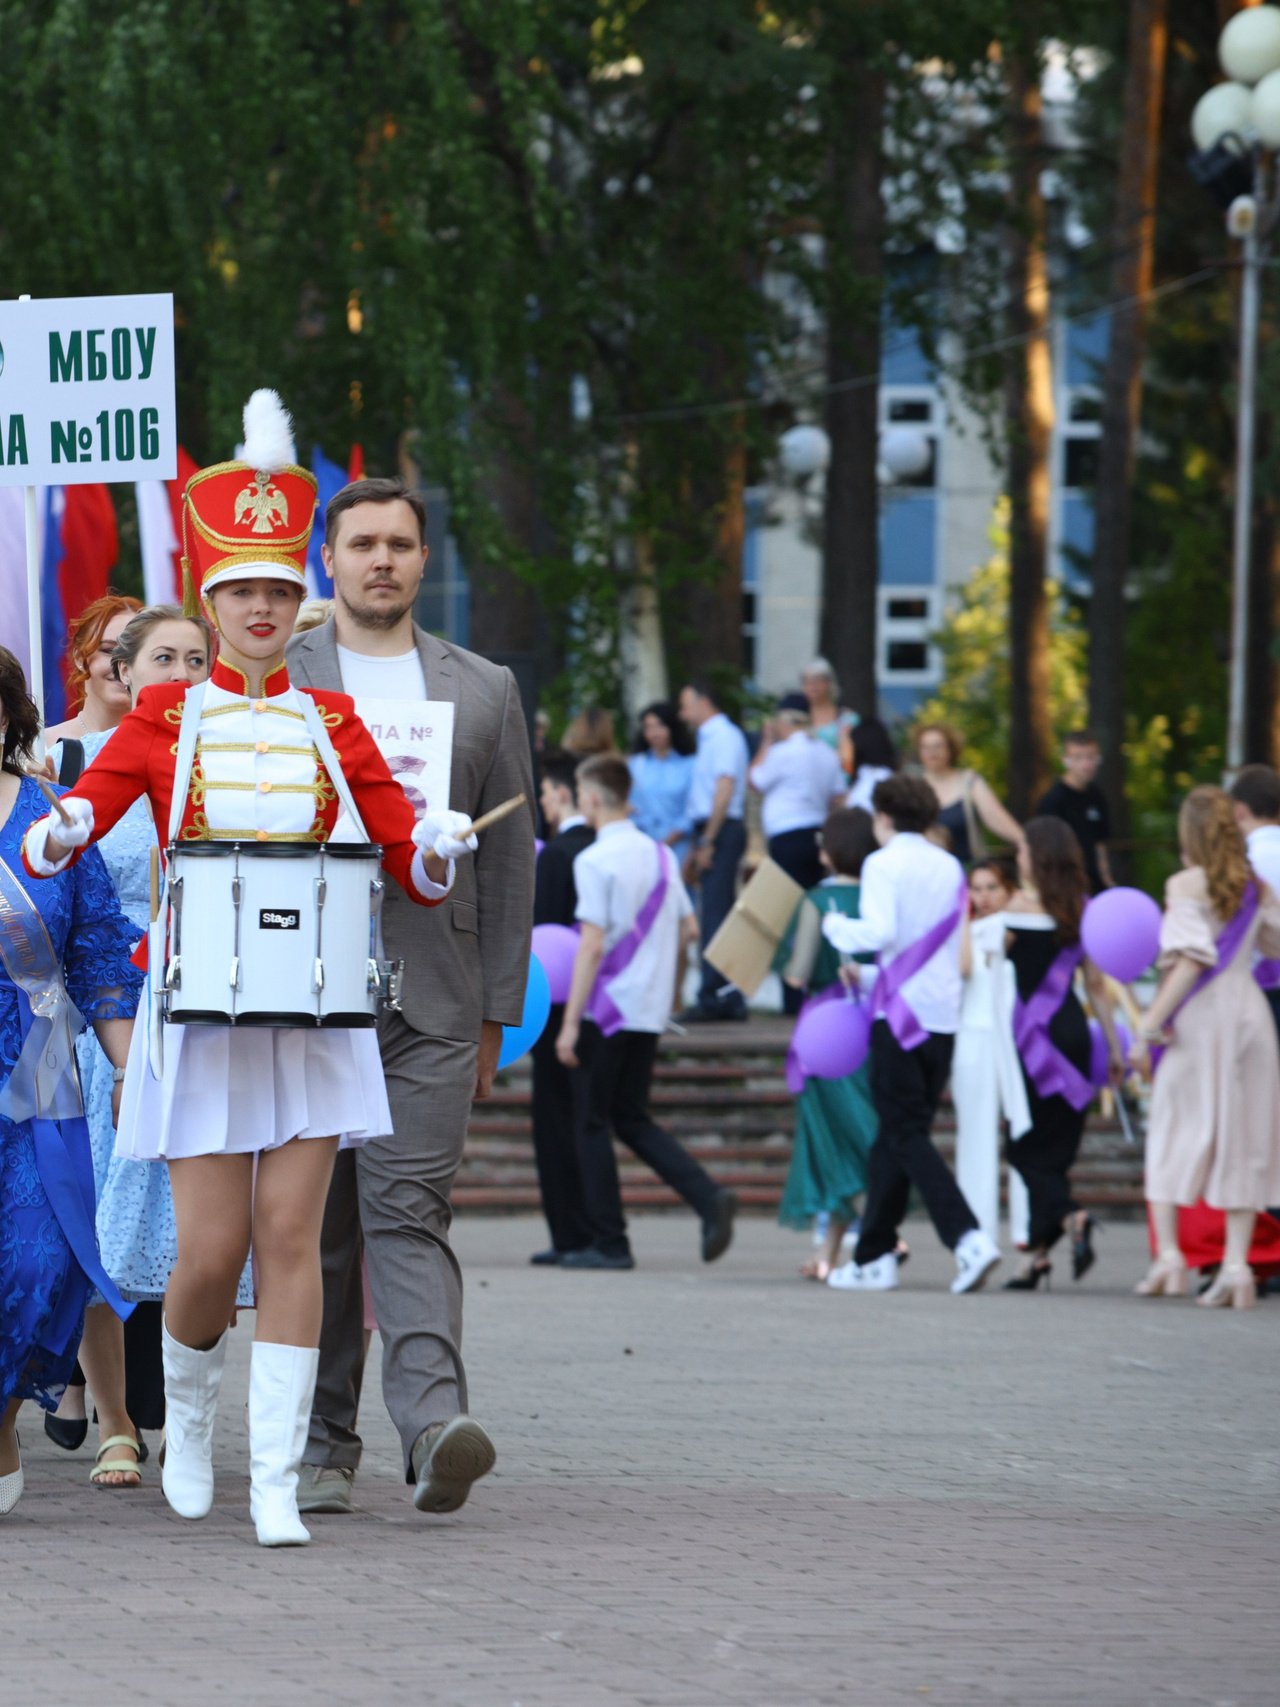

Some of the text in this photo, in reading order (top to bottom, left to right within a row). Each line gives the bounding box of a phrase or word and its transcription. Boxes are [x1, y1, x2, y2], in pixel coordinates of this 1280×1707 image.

[48, 327, 157, 383] МБОУ
[50, 407, 160, 464] №106
[410, 726, 433, 741] №
[262, 912, 297, 928] Stagg
